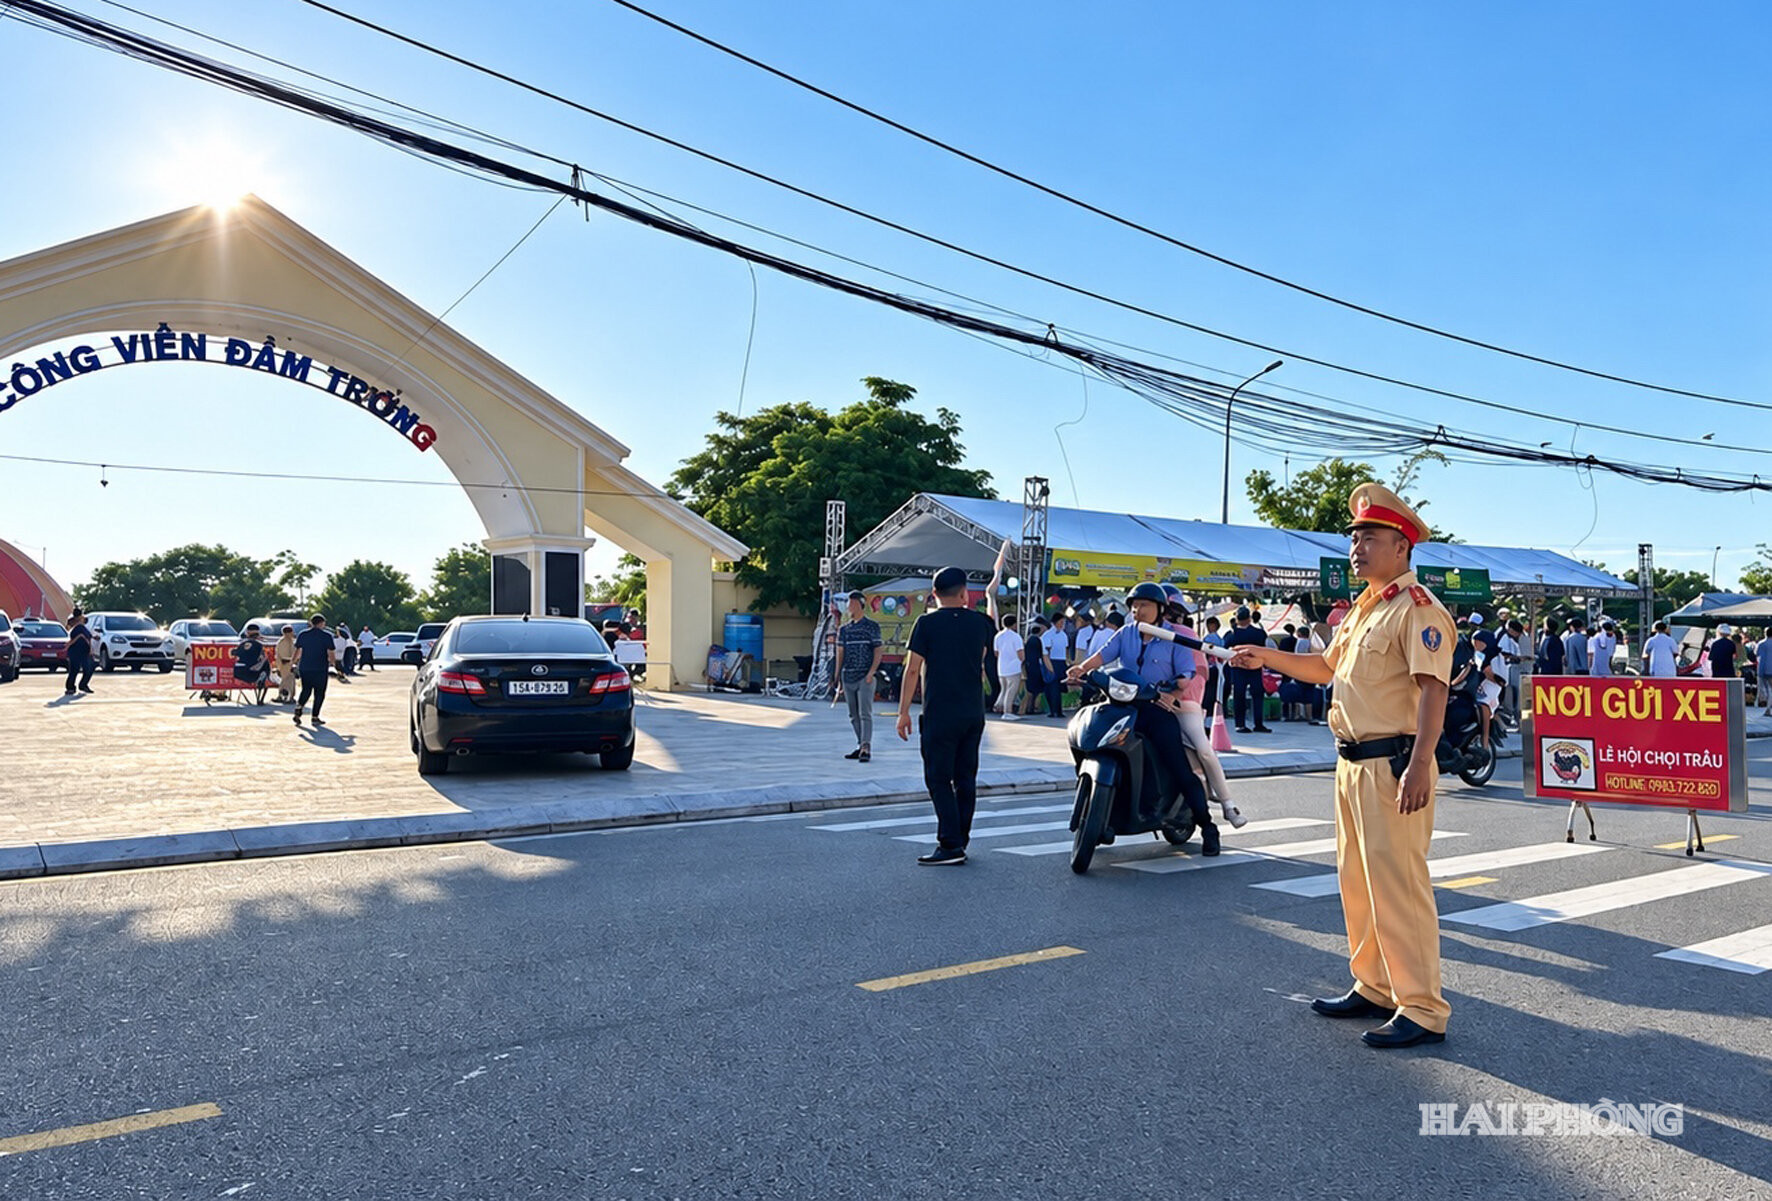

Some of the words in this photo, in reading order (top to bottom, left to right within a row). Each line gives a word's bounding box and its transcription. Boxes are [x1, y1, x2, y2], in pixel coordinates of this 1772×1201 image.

[110, 322, 206, 363] VIÊN
[1535, 685, 1592, 717] NƠI
[1602, 679, 1663, 720] GỬI
[1673, 688, 1722, 722] XE
[1617, 746, 1641, 768] HỘI
[1644, 750, 1680, 770] CHỌI
[1683, 749, 1723, 768] TRÂU
